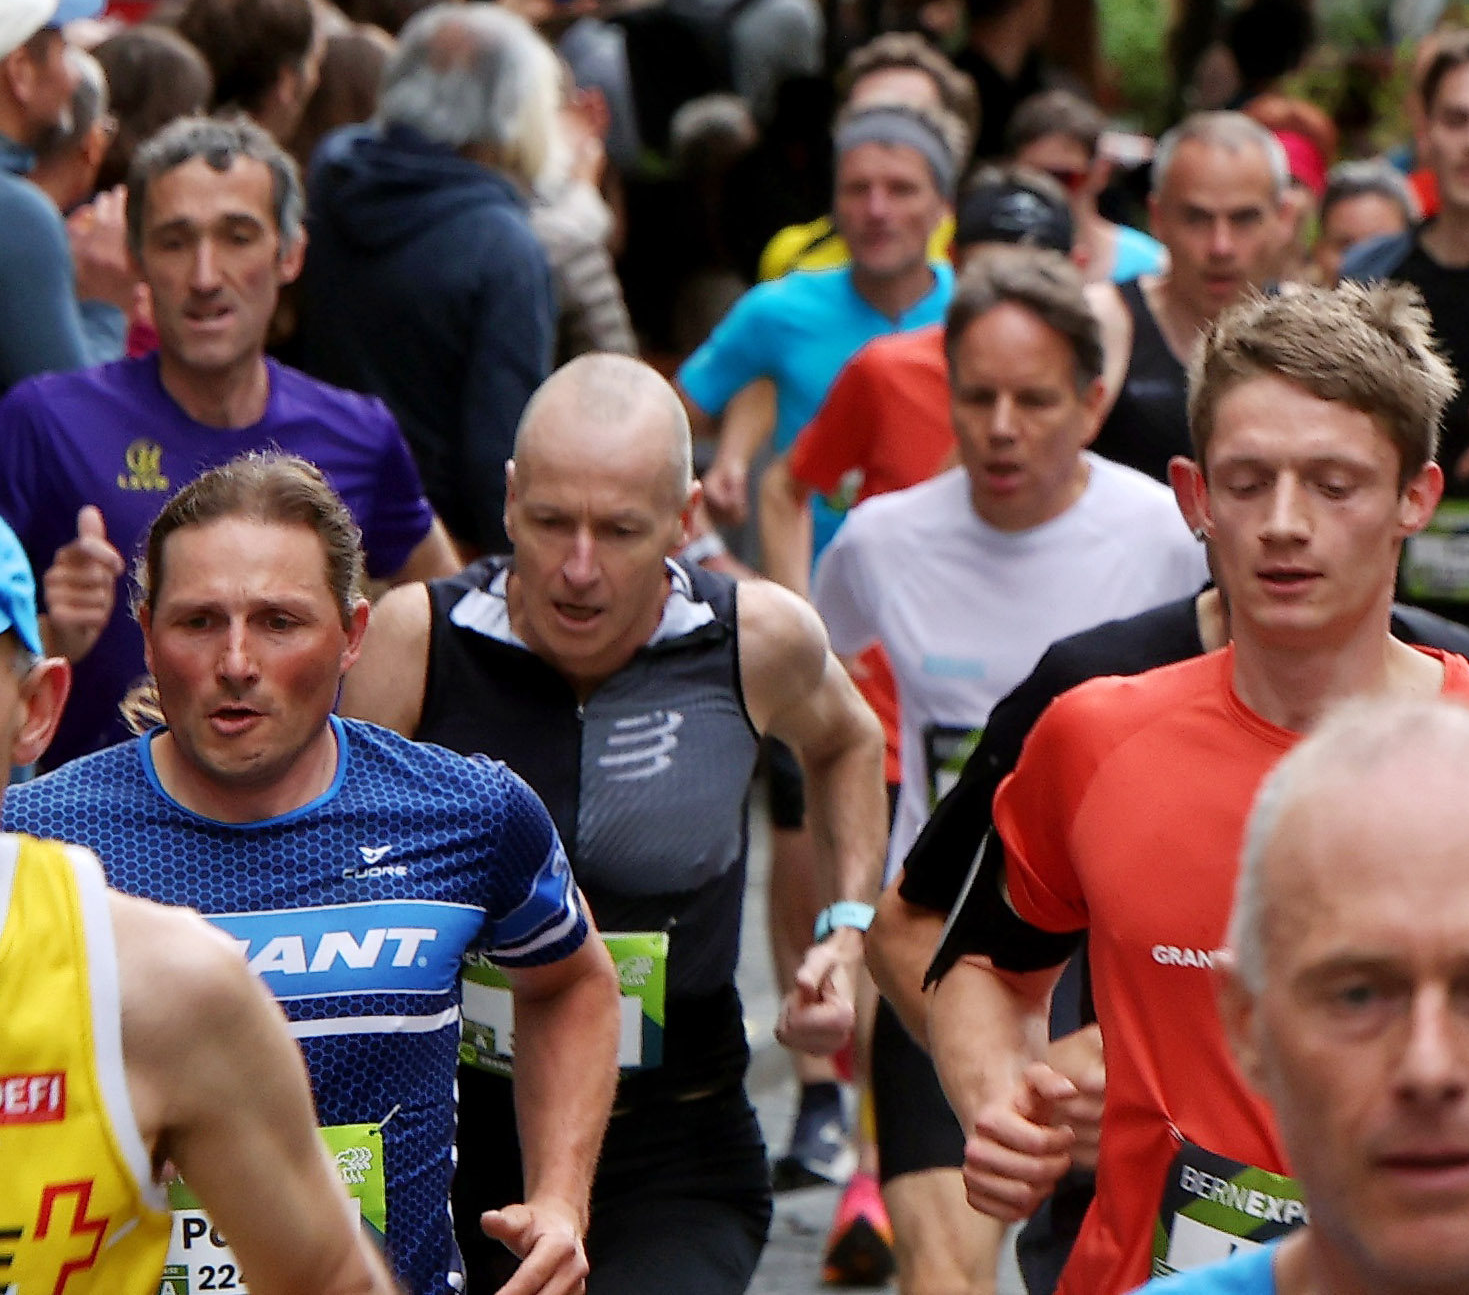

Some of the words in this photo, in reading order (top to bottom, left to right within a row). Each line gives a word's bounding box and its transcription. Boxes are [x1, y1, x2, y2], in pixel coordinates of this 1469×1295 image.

[342, 866, 407, 879] CUORE
[0, 1076, 62, 1112] EFI
[1179, 1163, 1310, 1226] BERNEXP
